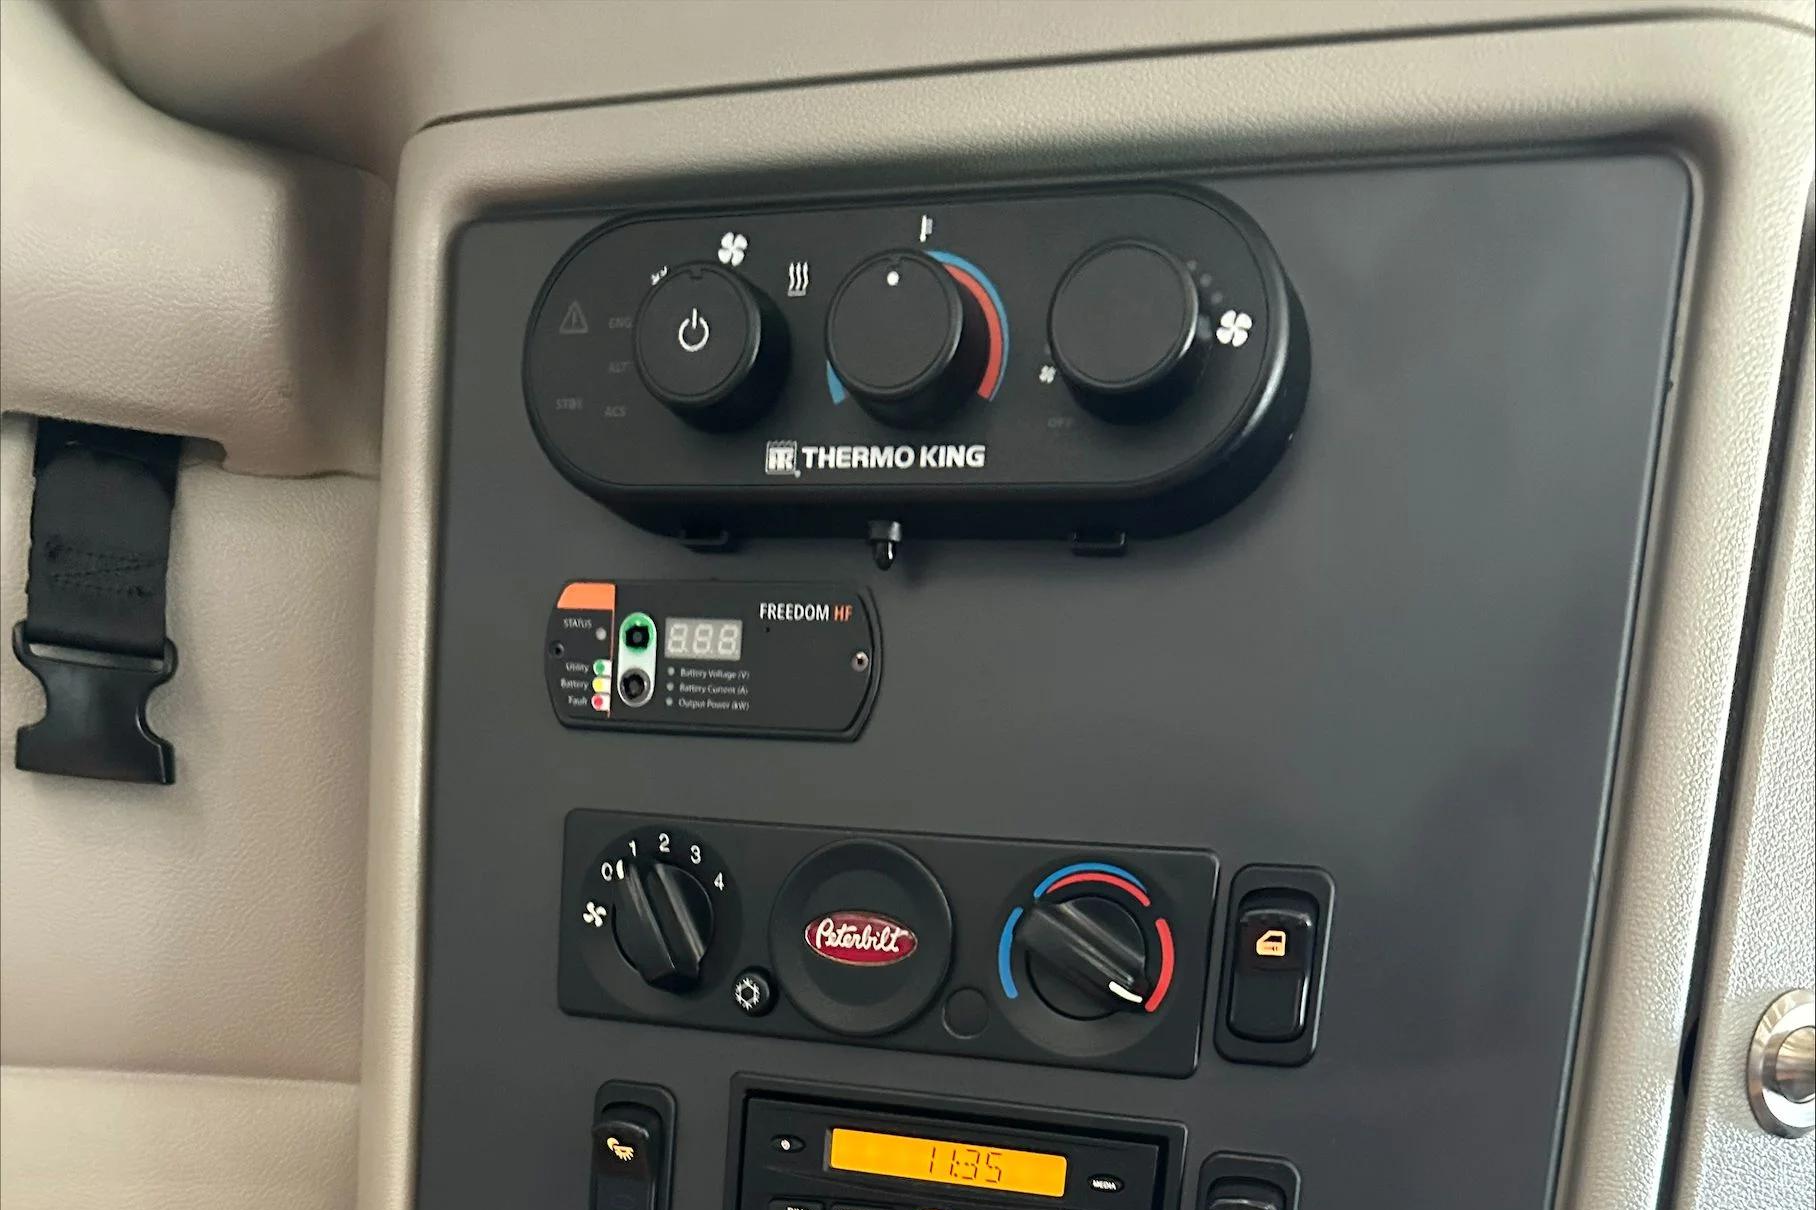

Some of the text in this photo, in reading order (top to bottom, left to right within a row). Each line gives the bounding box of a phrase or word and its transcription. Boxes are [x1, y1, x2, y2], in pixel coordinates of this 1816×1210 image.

[801, 445, 915, 469] THERMO
[919, 444, 986, 468] KING
[759, 602, 853, 621] FREEDOM HF
[563, 618, 592, 629] STATUS
[565, 661, 589, 674] Utility
[680, 667, 706, 679] Battery
[708, 669, 736, 680] Voltage
[560, 677, 588, 691] Battery
[679, 683, 705, 693] Battery
[707, 684, 735, 694] Current
[678, 697, 705, 710] Output
[706, 699, 730, 710] Power
[628, 840, 637, 857] 1
[659, 833, 671, 853] 2
[690, 845, 702, 865] 3
[713, 872, 725, 891] 4
[815, 917, 909, 952] Peterbilt
[928, 1146, 1003, 1184] 11:35
[1091, 1179, 1117, 1190] MEDIA
